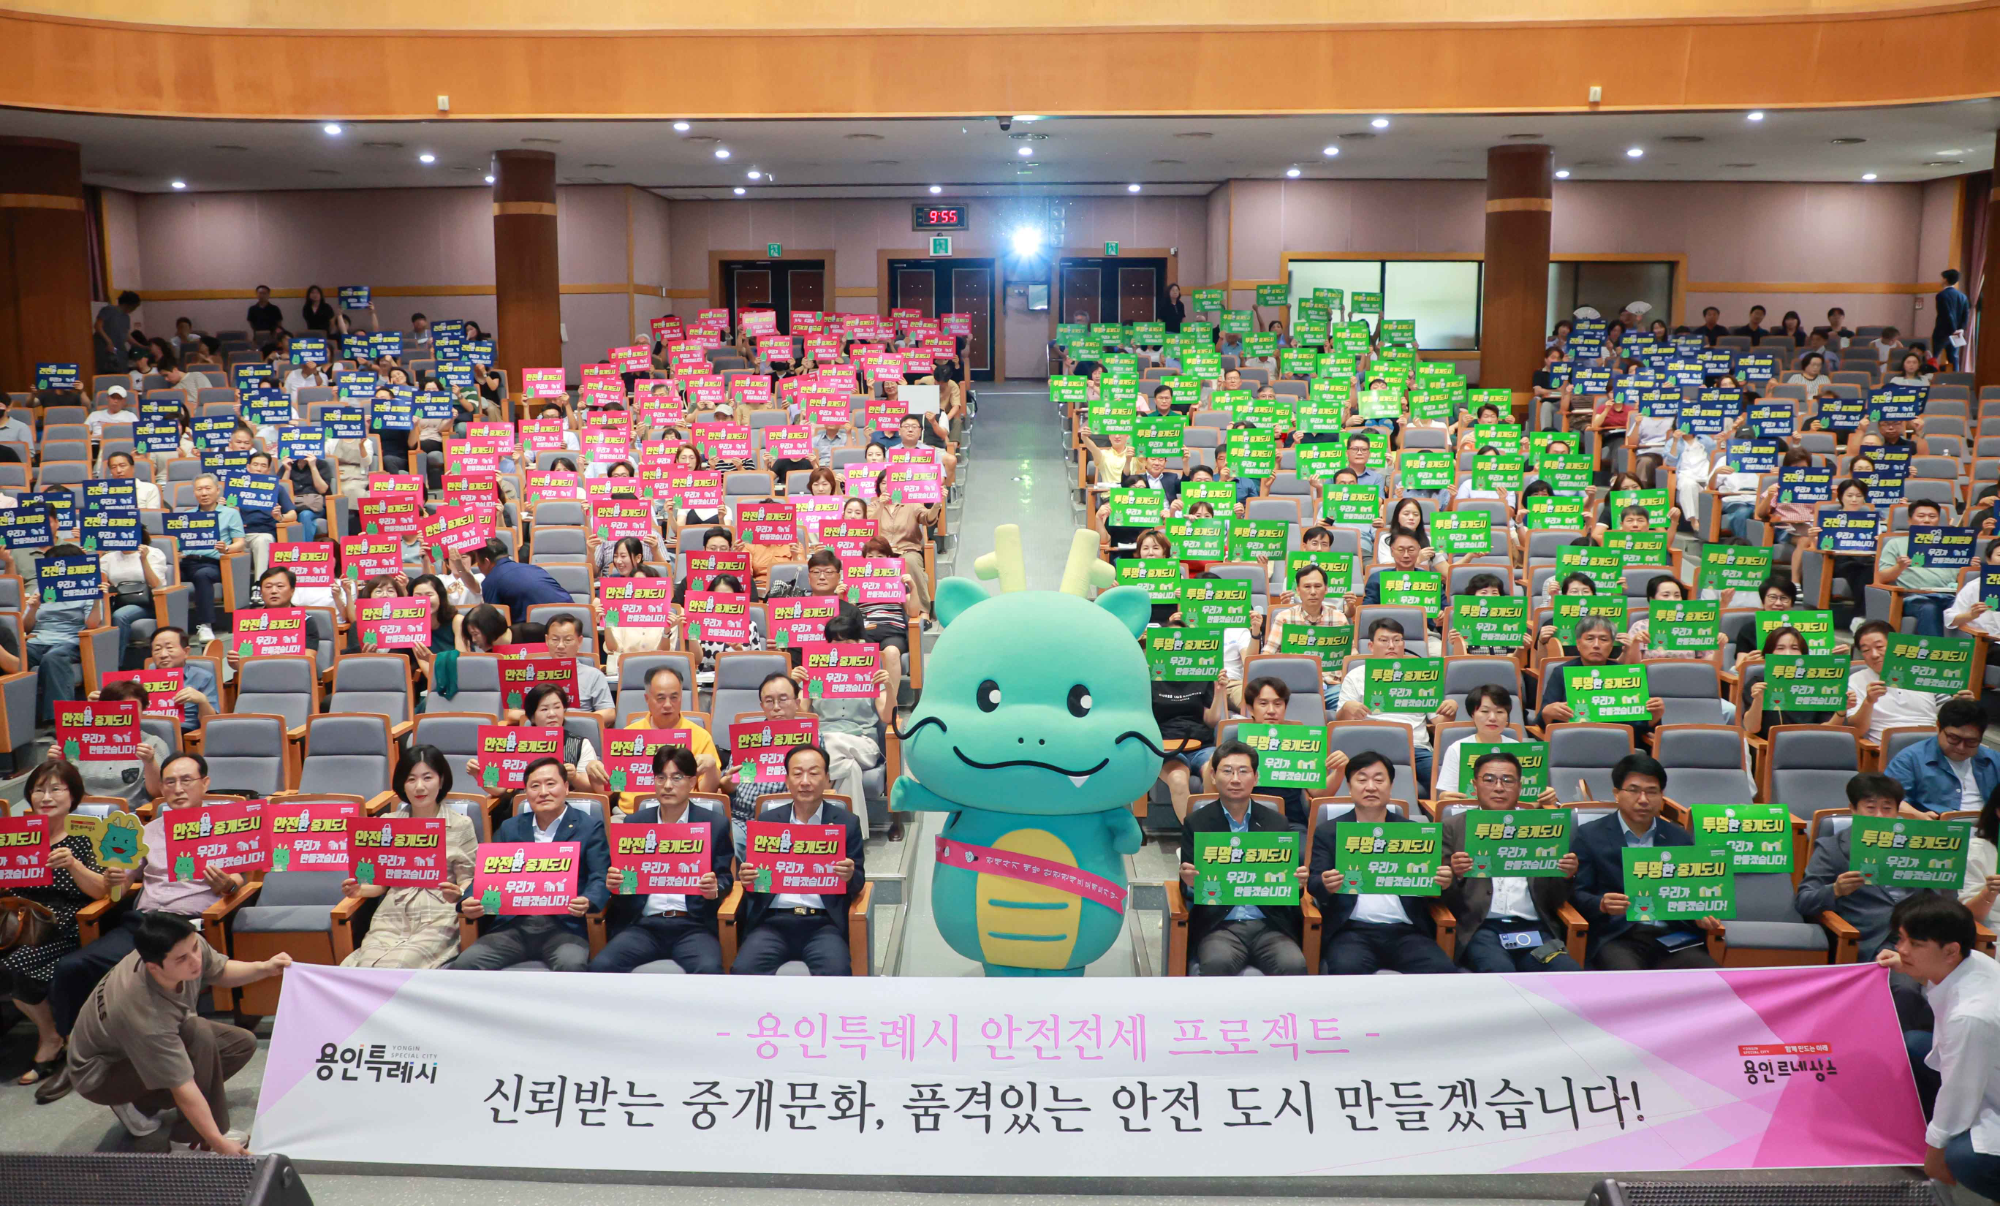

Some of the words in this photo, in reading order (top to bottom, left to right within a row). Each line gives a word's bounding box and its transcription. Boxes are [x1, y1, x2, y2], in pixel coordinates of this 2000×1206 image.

[605, 587, 633, 599] 안전한
[634, 589, 665, 598] 중개도시
[1186, 588, 1214, 600] 투명한
[1215, 590, 1246, 600] 중개도시
[362, 608, 391, 620] 안전한
[392, 607, 425, 618] 중개도시
[621, 604, 642, 612] 우리가
[1459, 604, 1489, 617] 투명한
[1489, 607, 1522, 617] 중개도시
[1656, 610, 1684, 622] 투명한
[1684, 611, 1716, 621] 중개도시
[240, 618, 268, 631] 안전한
[268, 618, 301, 629] 중개도시
[379, 624, 401, 634] 우리가
[255, 636, 276, 645] 우리가
[1152, 638, 1184, 650] 투명한
[1184, 640, 1219, 650] 중개도시
[1893, 644, 1929, 659] 투명한
[1928, 649, 1969, 663] 중개도시
[808, 654, 839, 667] 안전한
[839, 656, 873, 666] 중개도시
[1169, 656, 1192, 665] 우리가
[825, 673, 848, 682] 우리가
[1371, 669, 1403, 682] 투명한
[1403, 670, 1439, 681] 중개도시
[1371, 669, 1403, 682] 투명한
[1403, 670, 1439, 681] 중개도시
[1772, 665, 1806, 679] 투명한
[1806, 667, 1844, 678] 중개도시
[1571, 676, 1603, 690] 투명한
[1605, 677, 1639, 688] 중개도시
[1789, 685, 1814, 694] 우리가
[1388, 687, 1412, 696] 우리가
[1388, 687, 1412, 696] 우리가
[1591, 695, 1615, 705] 우리가
[60, 712, 93, 727] 안전한
[95, 714, 132, 726] 중개도시
[81, 733, 106, 743] 우리가
[482, 736, 517, 752] 안전한
[518, 740, 556, 753] 중개도시
[738, 733, 772, 748] 안전한
[773, 732, 812, 746] 중개도시
[1245, 734, 1280, 750] 투명한
[1281, 739, 1320, 752] 중개도시
[1264, 757, 1290, 768] 우리가
[171, 821, 213, 841] 안전한
[215, 815, 261, 835] 중개도시
[273, 816, 310, 832] 안전한
[1701, 816, 1740, 833] 투명한
[1742, 819, 1783, 832] 중개도시
[1475, 823, 1516, 839] 투명한
[1516, 824, 1564, 838] 중개도시
[293, 839, 320, 851] 우리가
[354, 830, 393, 847] 안전한
[394, 833, 438, 847] 중개도시
[752, 835, 793, 853] 안전한
[793, 840, 837, 854] 중개도시
[1344, 836, 1387, 853] 투명한
[1387, 839, 1434, 853] 중개도시
[1861, 830, 1908, 848] 투명한
[1908, 835, 1961, 850] 중개도시
[197, 843, 228, 857] 우리가
[618, 837, 657, 854] 안전한
[658, 840, 703, 853] 중개도시
[1496, 846, 1527, 857] 우리가
[377, 854, 406, 866] 우리가
[1203, 846, 1244, 863] 투명한
[1245, 848, 1291, 862] 중개도시
[1885, 855, 1920, 867] 우리가
[483, 856, 525, 873] 안전한
[525, 858, 571, 871] 중개도시
[640, 861, 670, 873] 우리가
[775, 860, 805, 873] 우리가
[1367, 861, 1398, 873] 우리가
[1632, 861, 1676, 878] 투명한
[1677, 862, 1725, 877] 중개도시
[1225, 871, 1256, 883] 우리가
[505, 880, 536, 893] 우리가
[1658, 886, 1690, 898] 우리가
[747, 1012, 958, 1063] 용인특례시
[981, 1013, 1147, 1063] 안전전세
[1168, 1012, 1351, 1062] 프로젝트
[315, 1042, 438, 1084] 용인특례시
[485, 1074, 665, 1128] 신뢰받는
[682, 1079, 885, 1134] 중개문화,
[902, 1081, 1092, 1134] 품격있는
[1112, 1081, 1203, 1133] 안전
[1224, 1080, 1314, 1134] 도시
[1335, 1076, 1646, 1133] 만들겠습니다!
